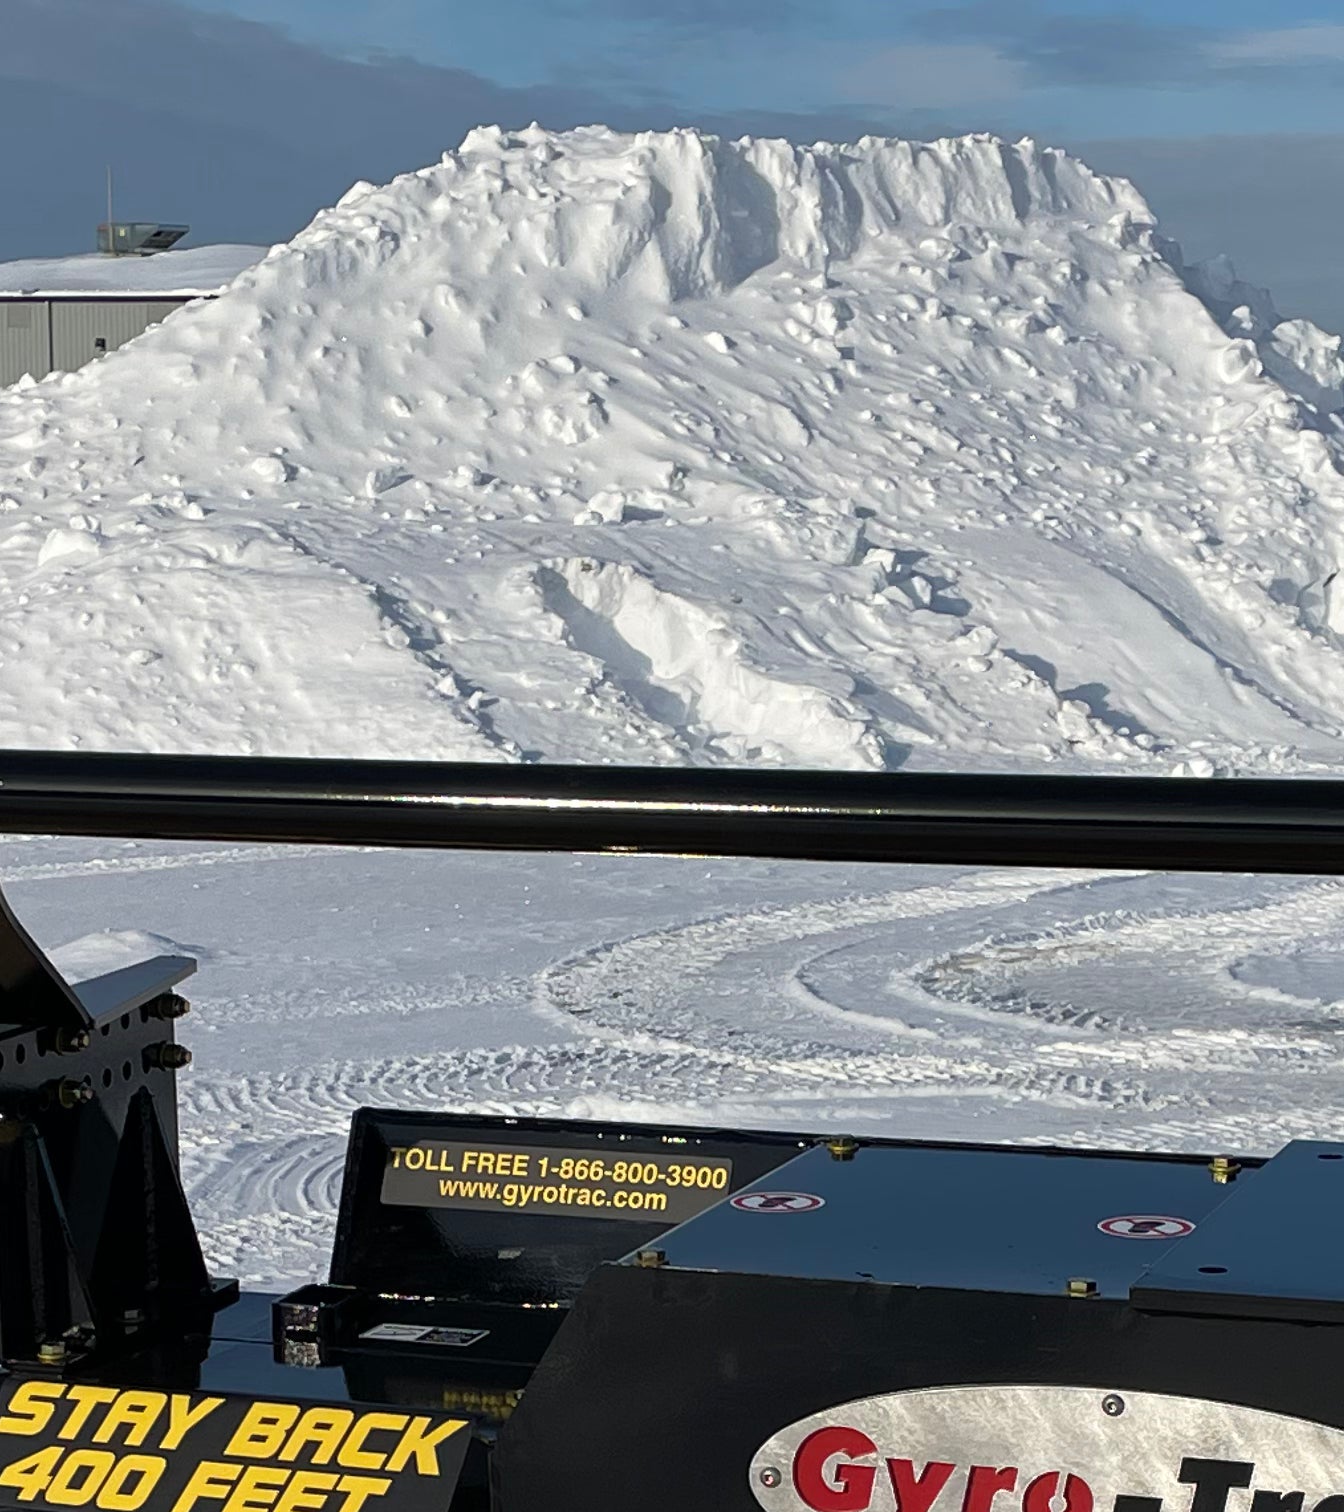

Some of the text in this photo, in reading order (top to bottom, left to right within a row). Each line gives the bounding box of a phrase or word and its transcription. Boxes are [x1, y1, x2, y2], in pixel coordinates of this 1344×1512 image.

[391, 1147, 727, 1189] TOLL FREE 1-866-800-3900
[439, 1177, 667, 1211] www.gyrotrac.com
[222, 1403, 472, 1476] BACK
